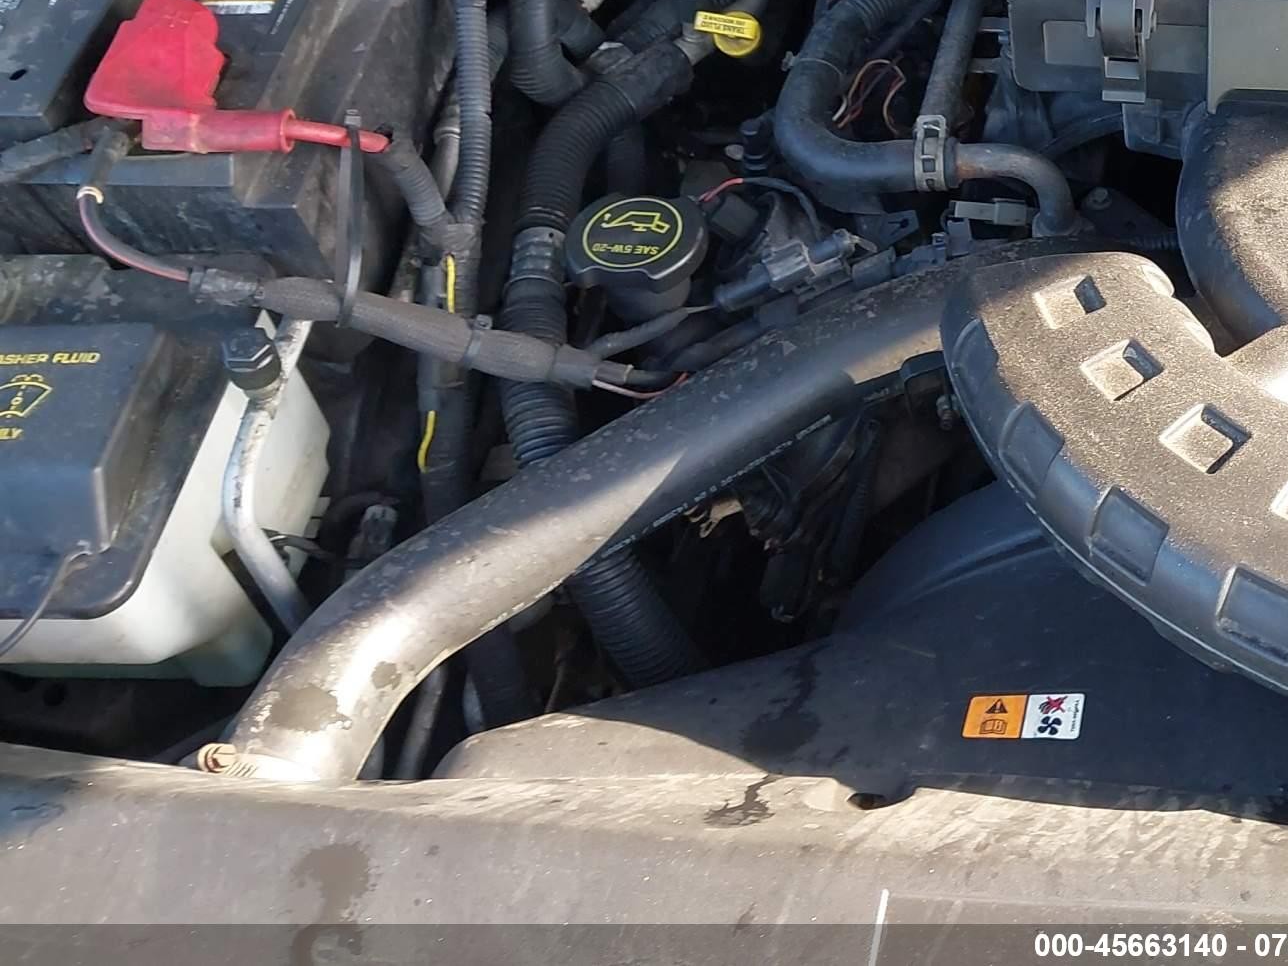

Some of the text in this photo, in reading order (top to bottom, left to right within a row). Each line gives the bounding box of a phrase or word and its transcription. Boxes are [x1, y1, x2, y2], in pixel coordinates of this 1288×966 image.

[592, 243, 659, 255] SAE 5W-20
[52, 353, 100, 363] FLUID
